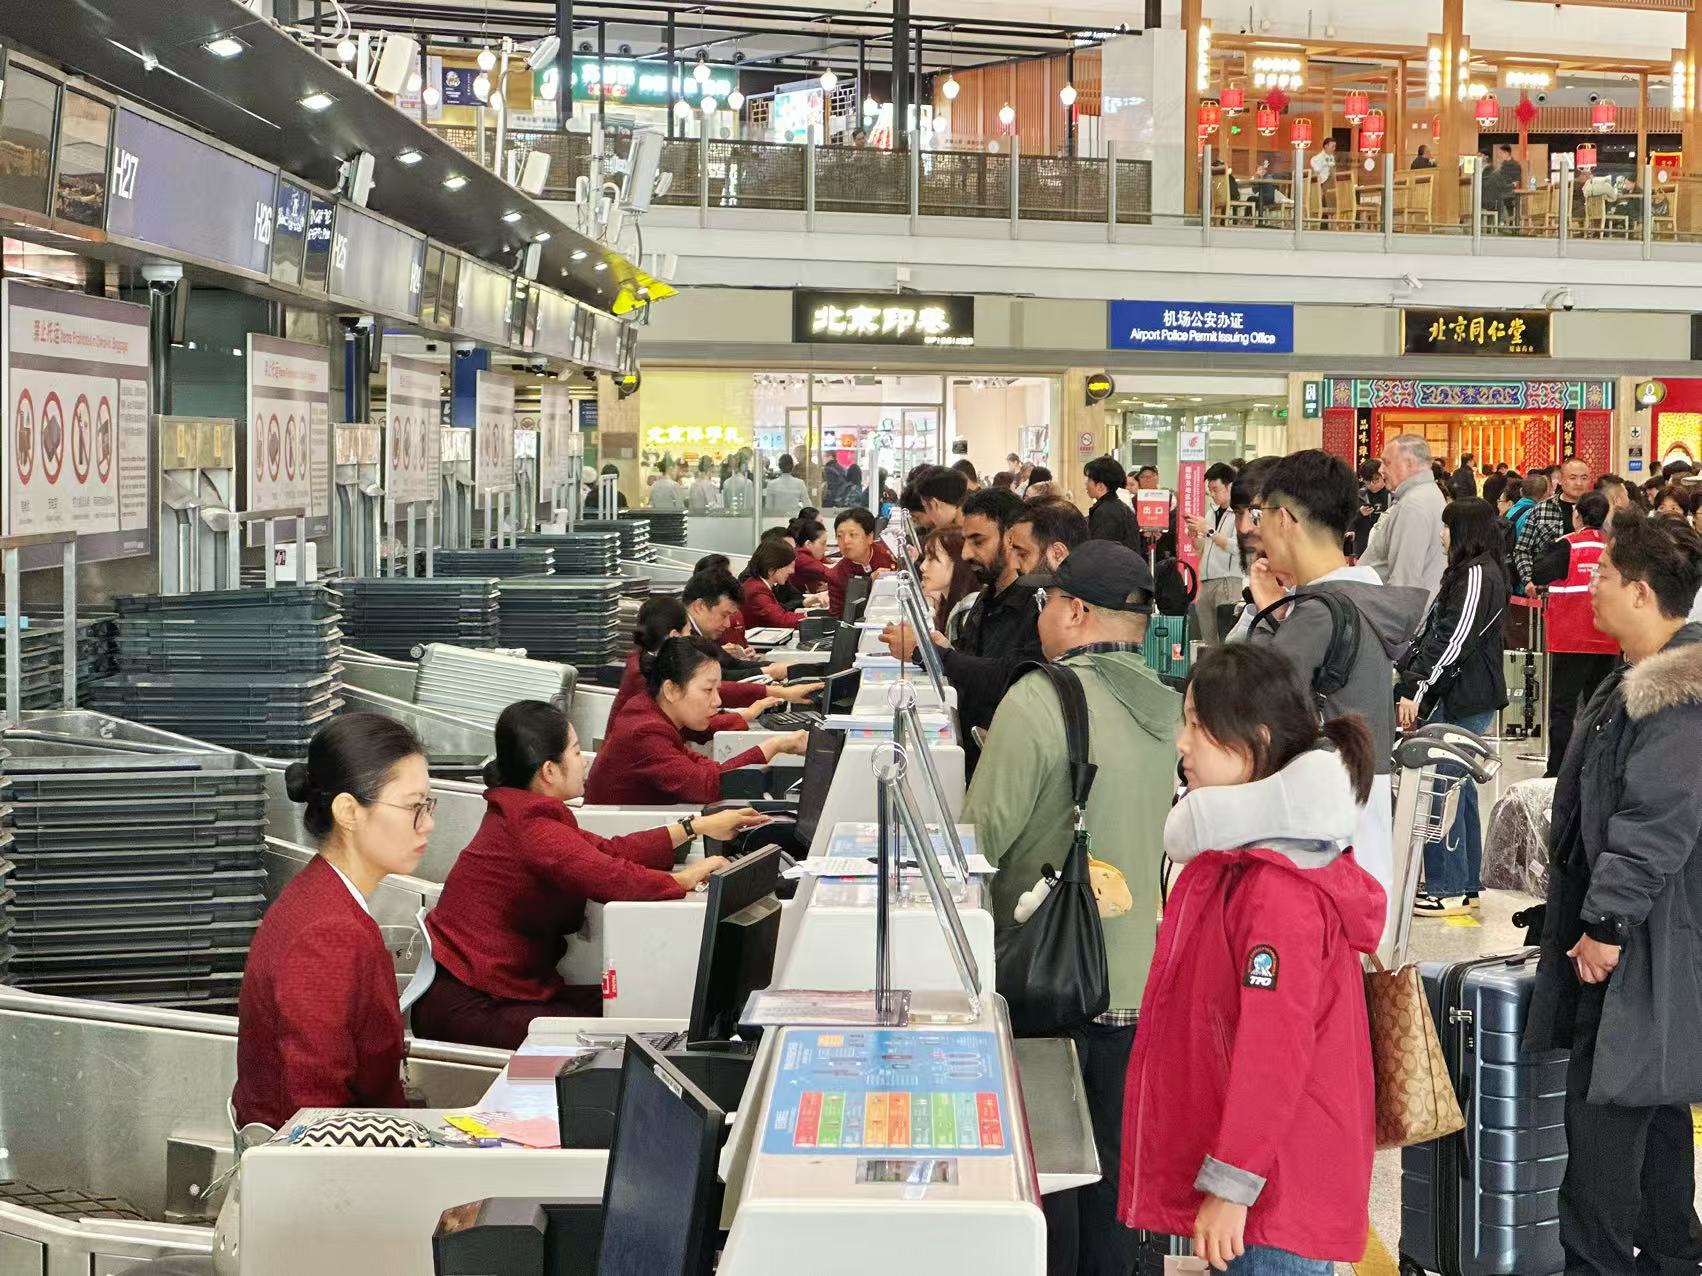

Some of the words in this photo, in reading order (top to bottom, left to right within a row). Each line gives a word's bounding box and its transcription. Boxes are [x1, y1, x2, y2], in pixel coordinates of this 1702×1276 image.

[112, 147, 139, 199] H27
[254, 201, 272, 244] H26
[1163, 310, 1244, 328] 机场公安办证
[1428, 315, 1527, 344] 北京同仁堂
[1130, 328, 1160, 342] Airport
[1161, 329, 1188, 342] Police
[1189, 331, 1218, 342] Permit
[1218, 332, 1249, 346] Issuing
[1250, 332, 1276, 344] Office
